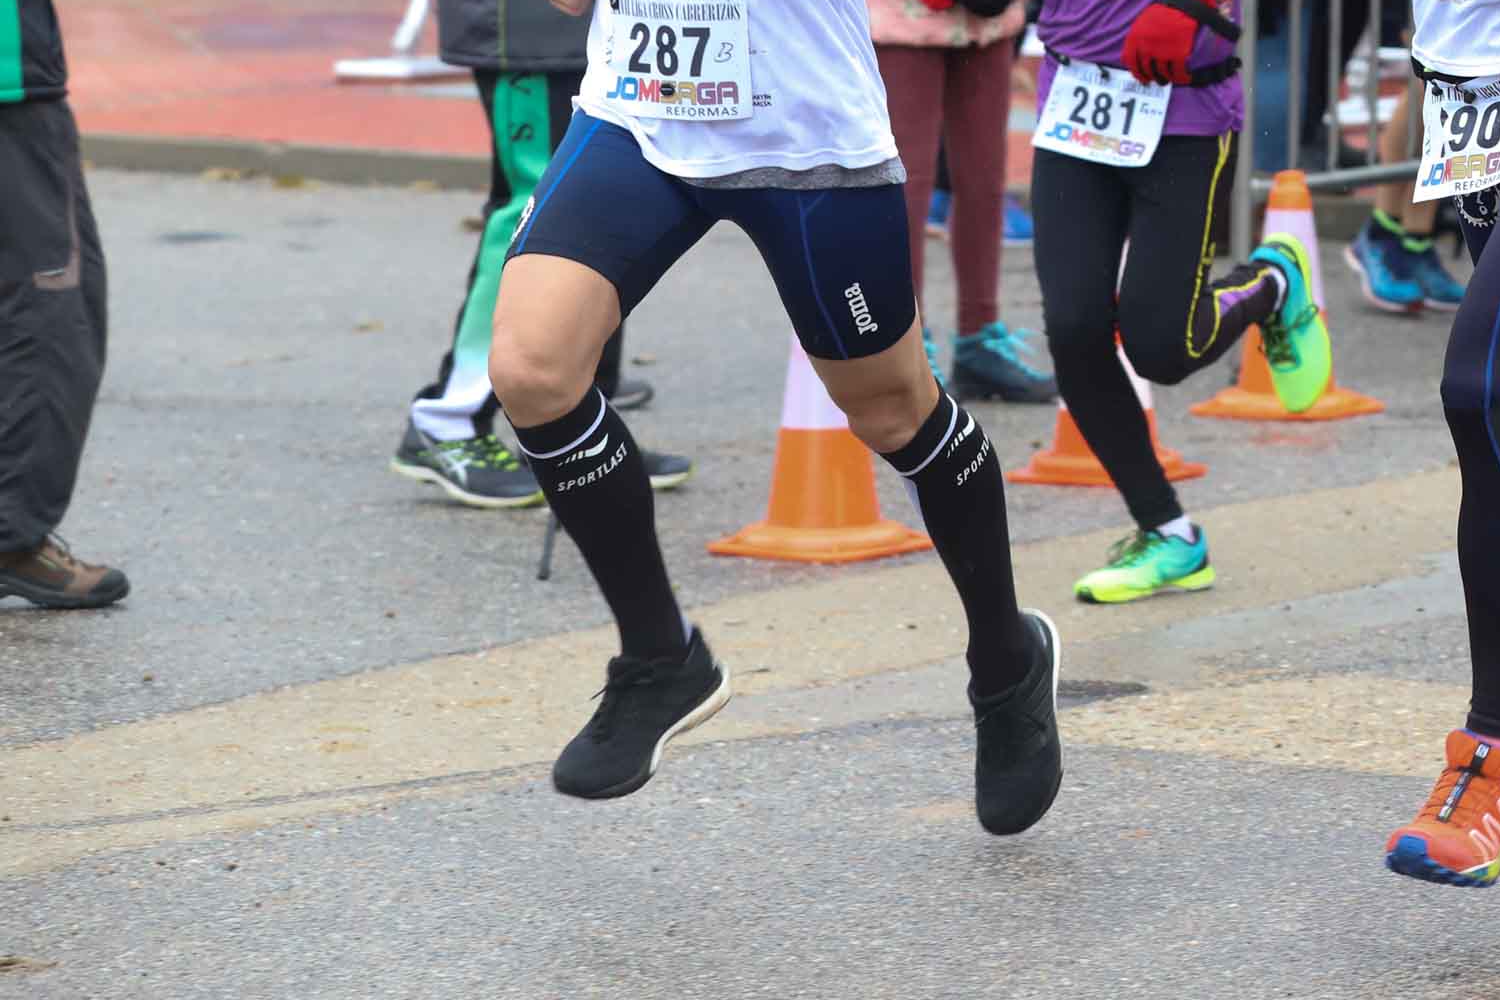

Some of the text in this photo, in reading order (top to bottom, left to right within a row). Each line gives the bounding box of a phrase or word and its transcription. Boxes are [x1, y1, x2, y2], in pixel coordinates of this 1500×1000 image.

[675, 2, 742, 21] CABRERIZOS
[628, 22, 711, 77] 287
[666, 106, 739, 117] REFORMAS
[1069, 86, 1136, 136] 281
[557, 441, 628, 493] SPORTLAST
